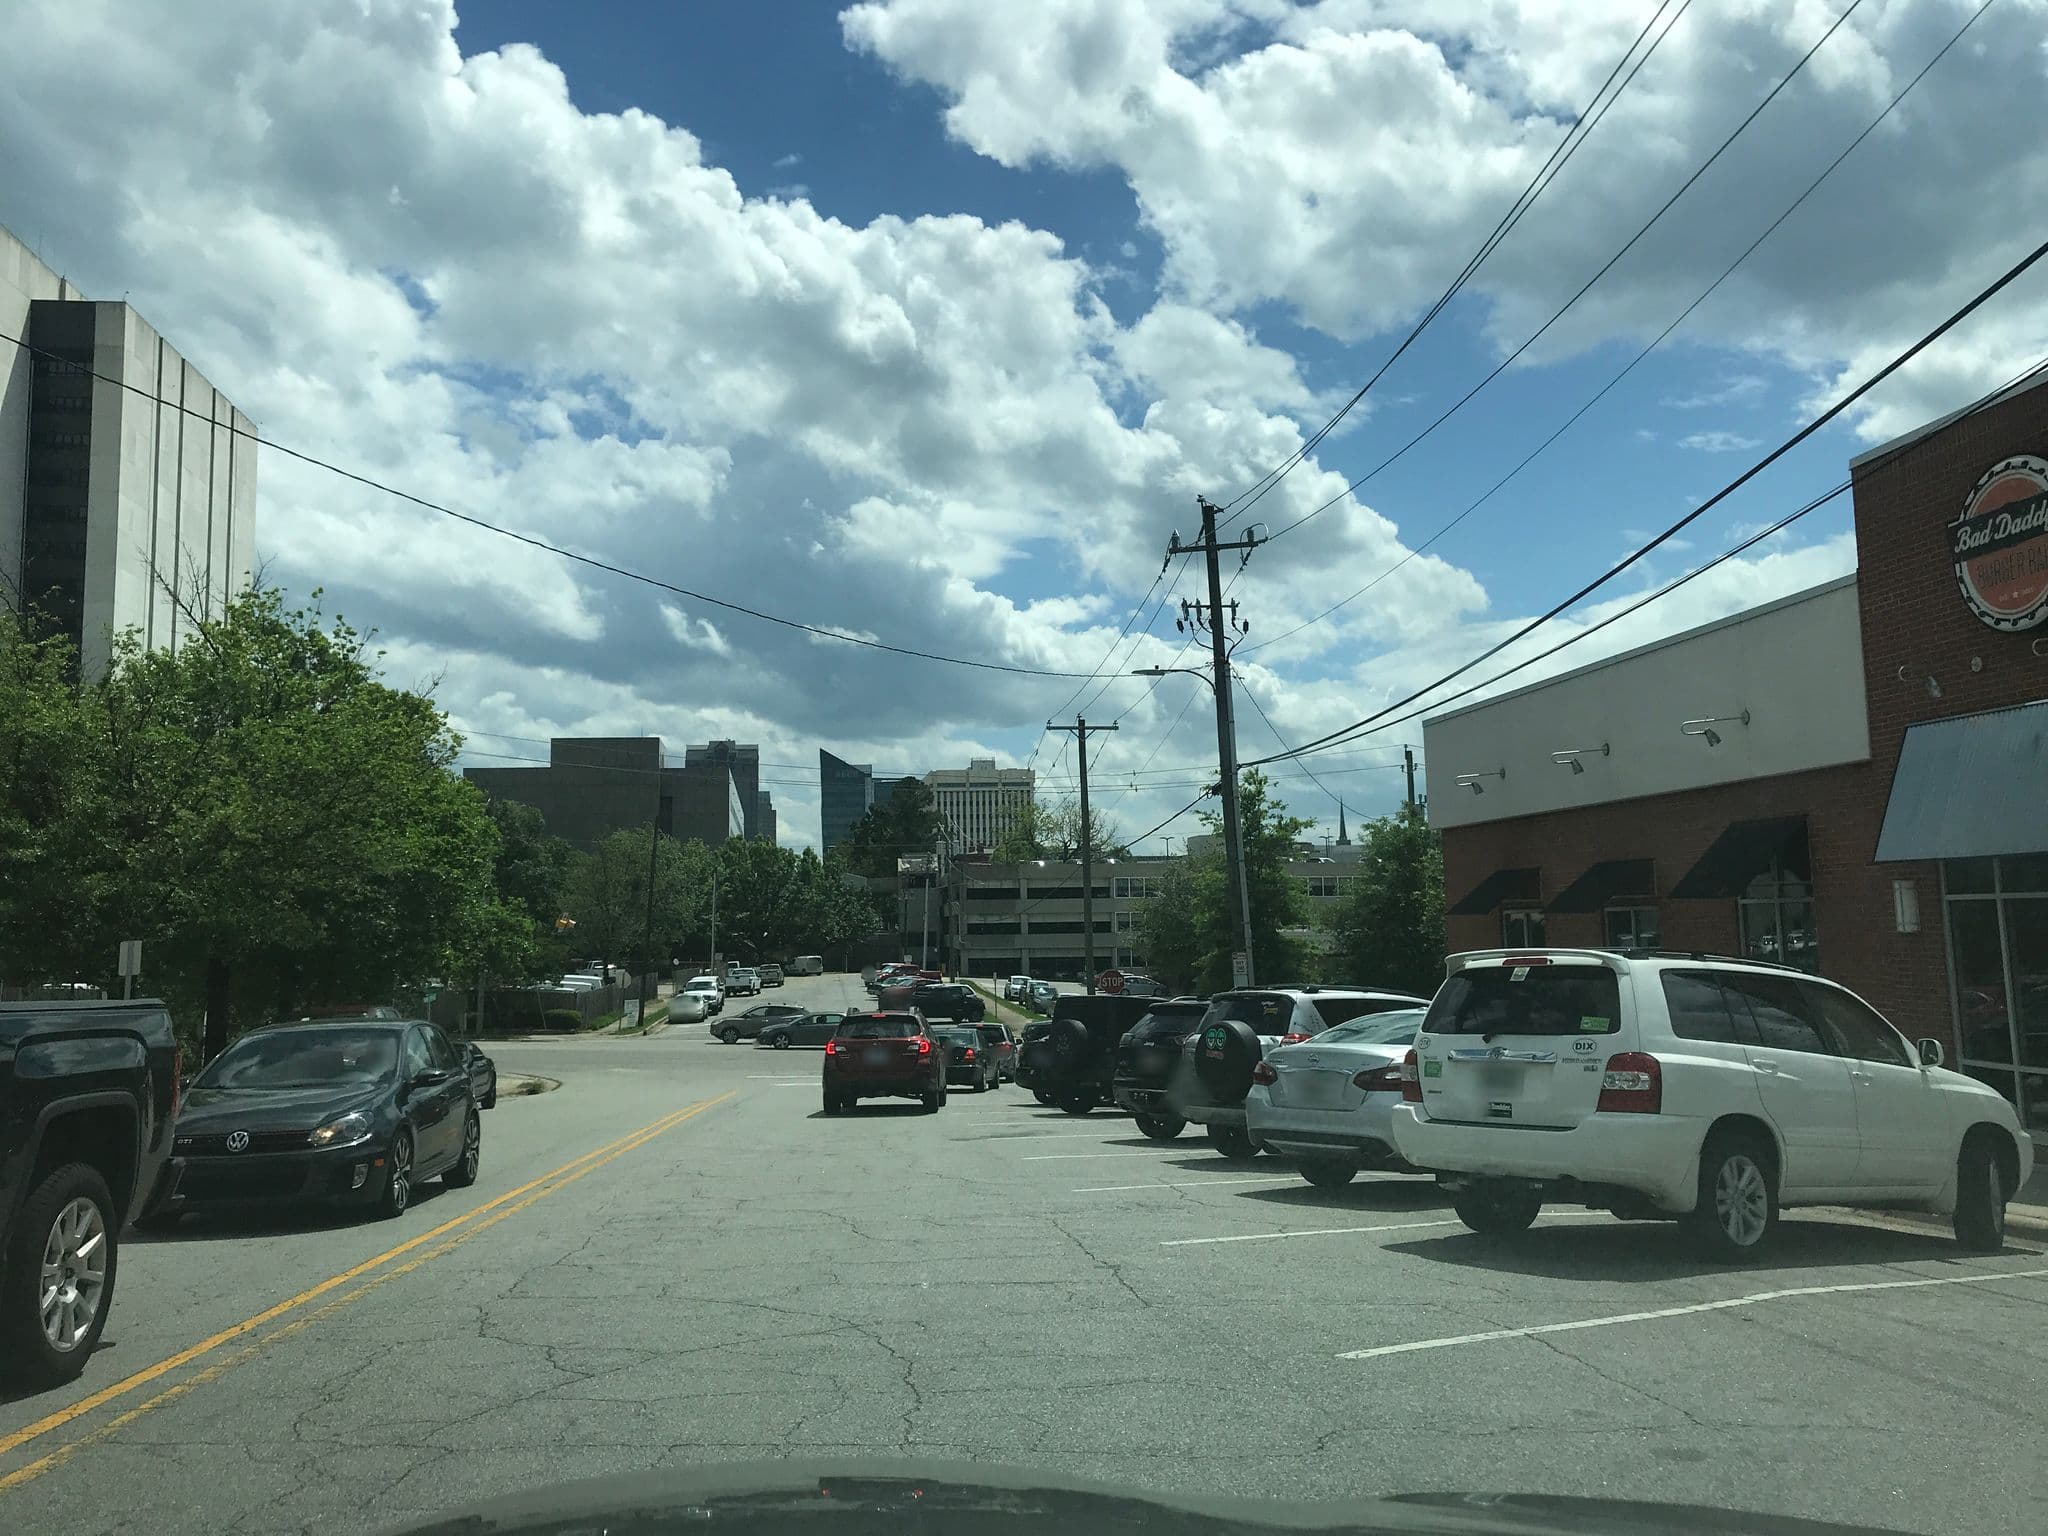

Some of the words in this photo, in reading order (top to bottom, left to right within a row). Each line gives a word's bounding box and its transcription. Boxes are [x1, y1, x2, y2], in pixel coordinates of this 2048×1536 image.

[1954, 517, 1993, 553] Bad
[1102, 976, 1124, 987] STOP
[1575, 1042, 1594, 1051] DIX
